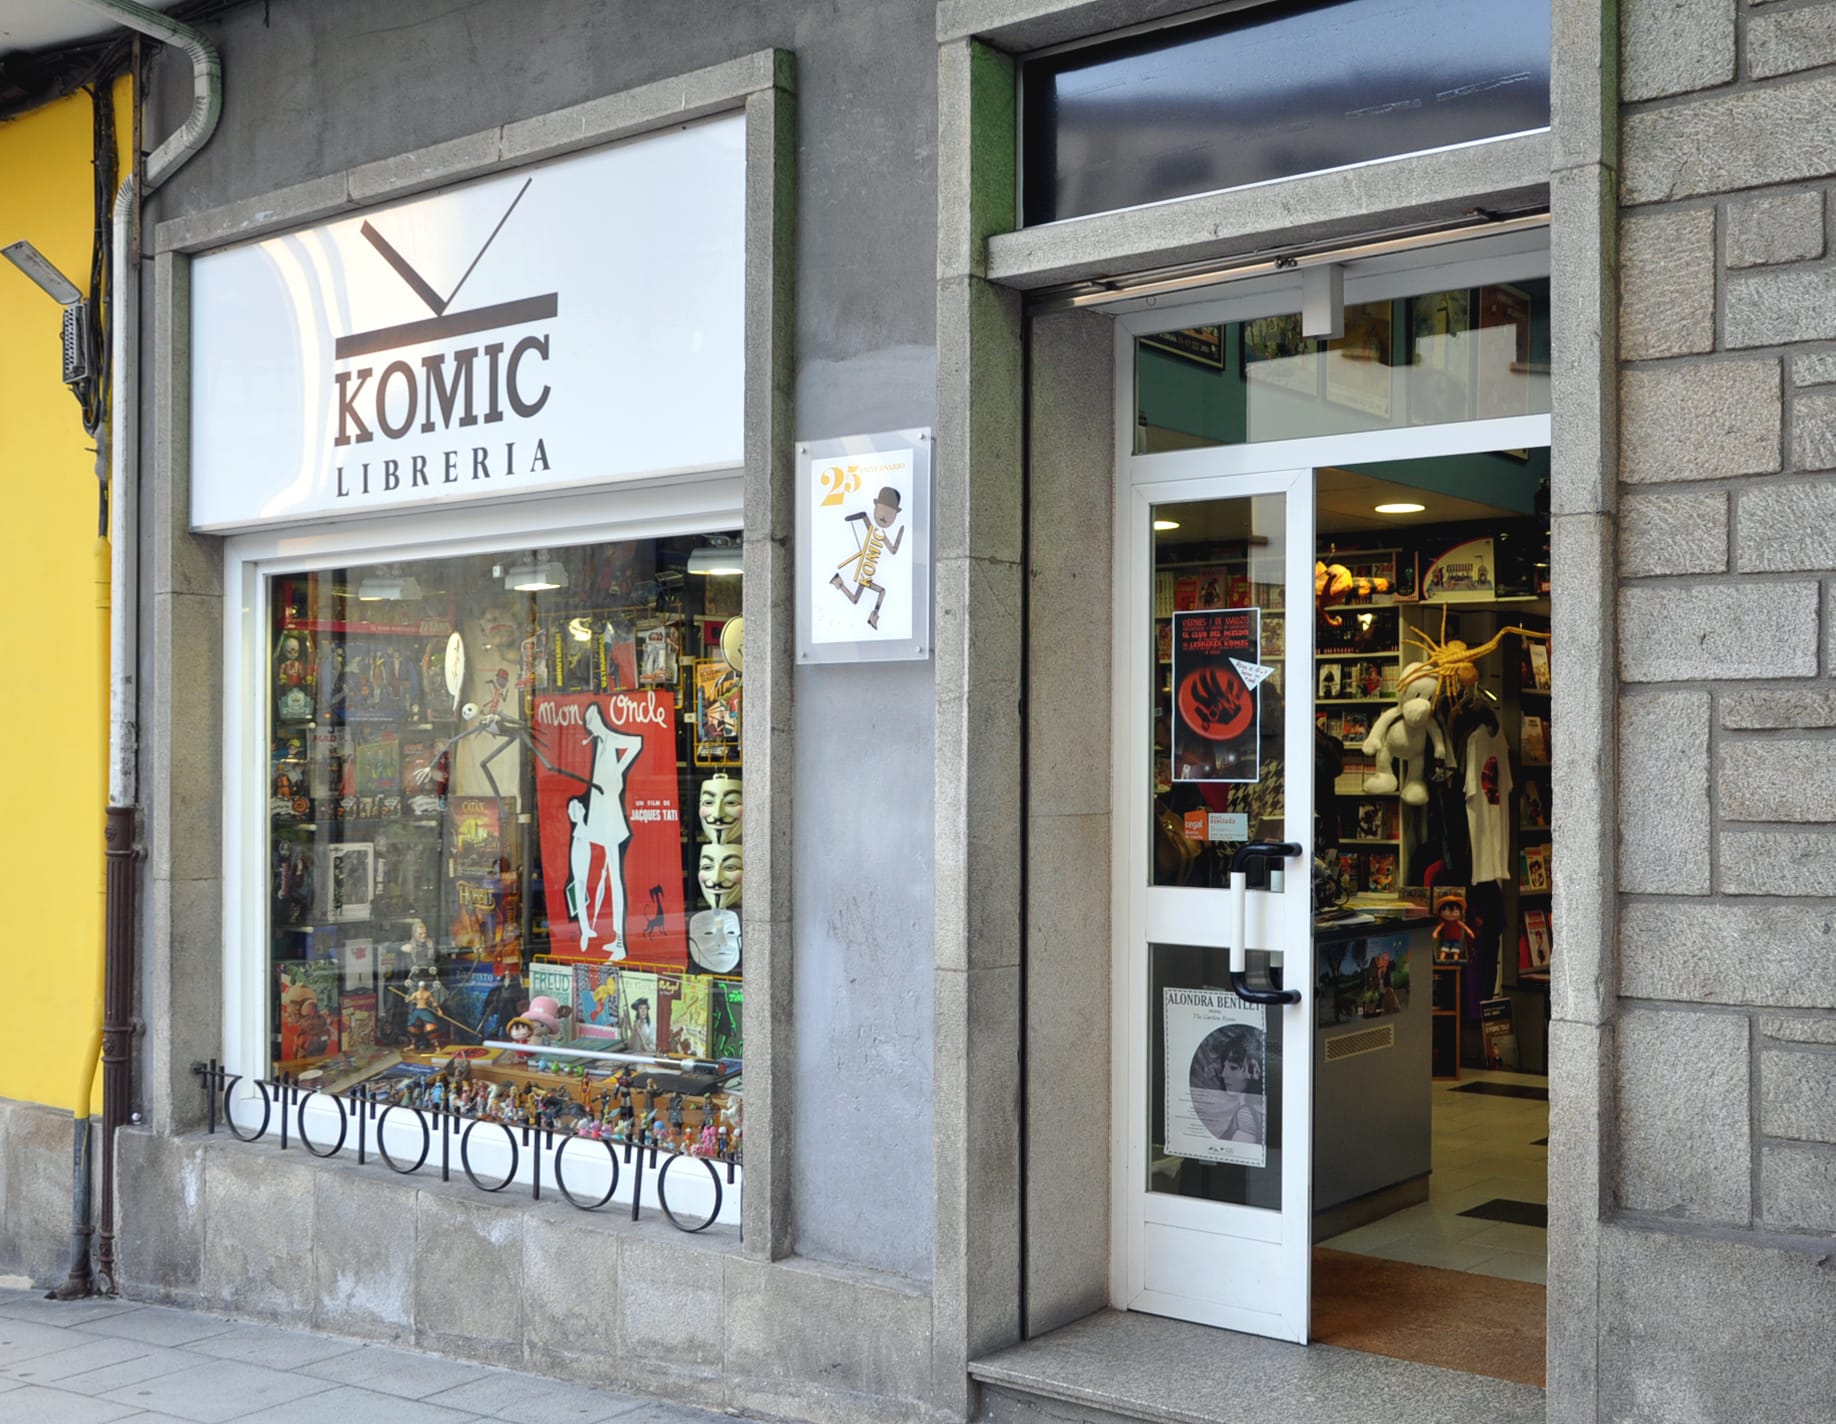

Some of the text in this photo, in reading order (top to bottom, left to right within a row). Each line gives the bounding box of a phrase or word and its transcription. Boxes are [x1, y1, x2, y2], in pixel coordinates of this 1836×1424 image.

[334, 334, 552, 447] KOMIC
[336, 438, 552, 497] LIBRERIA
[820, 465, 862, 507] 25
[858, 527, 888, 588] KOMIC
[610, 690, 668, 728] Oncle
[630, 809, 679, 824] JACQUES TATI
[533, 971, 570, 993] FREUD
[1168, 992, 1214, 1008] ALONDRA
